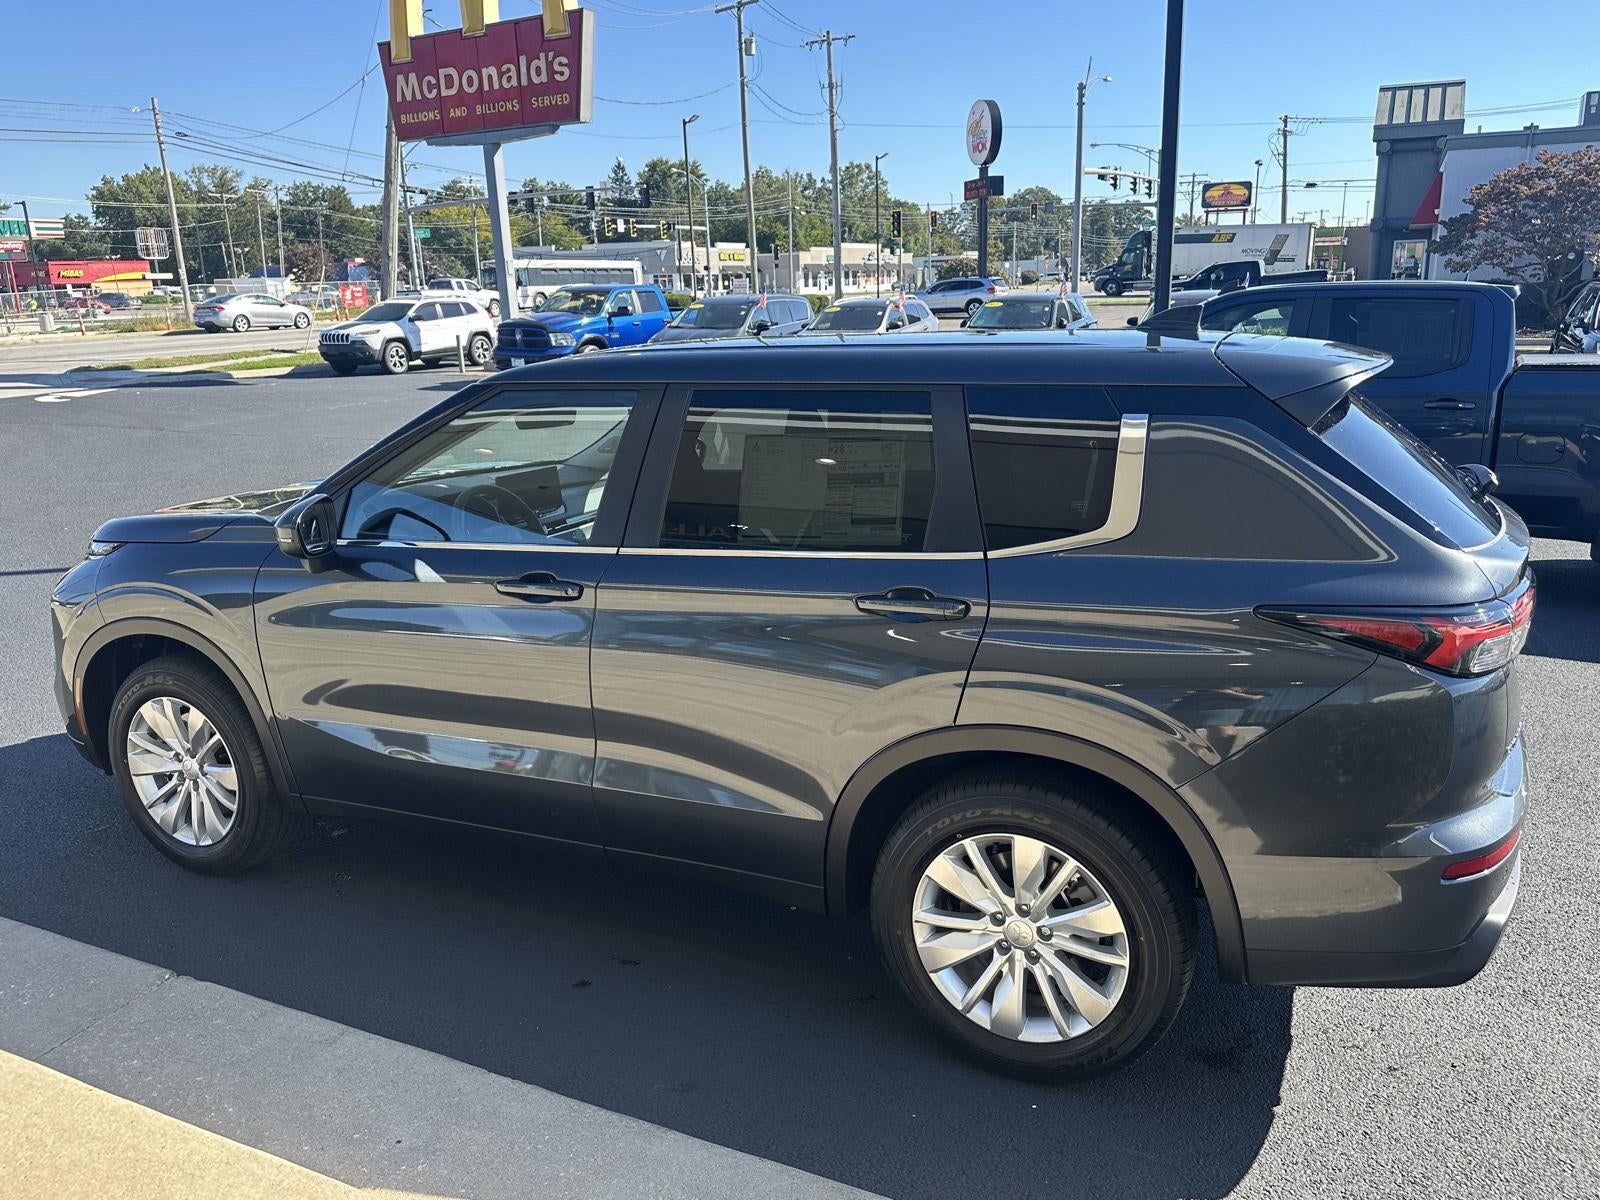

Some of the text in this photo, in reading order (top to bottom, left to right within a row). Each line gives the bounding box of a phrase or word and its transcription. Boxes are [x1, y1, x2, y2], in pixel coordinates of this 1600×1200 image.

[396, 52, 571, 103] McDonald's
[400, 93, 570, 124] BILLIONS AND BILLIONS SERVED
[971, 140, 988, 153] WOK
[1211, 233, 1233, 243] ABF
